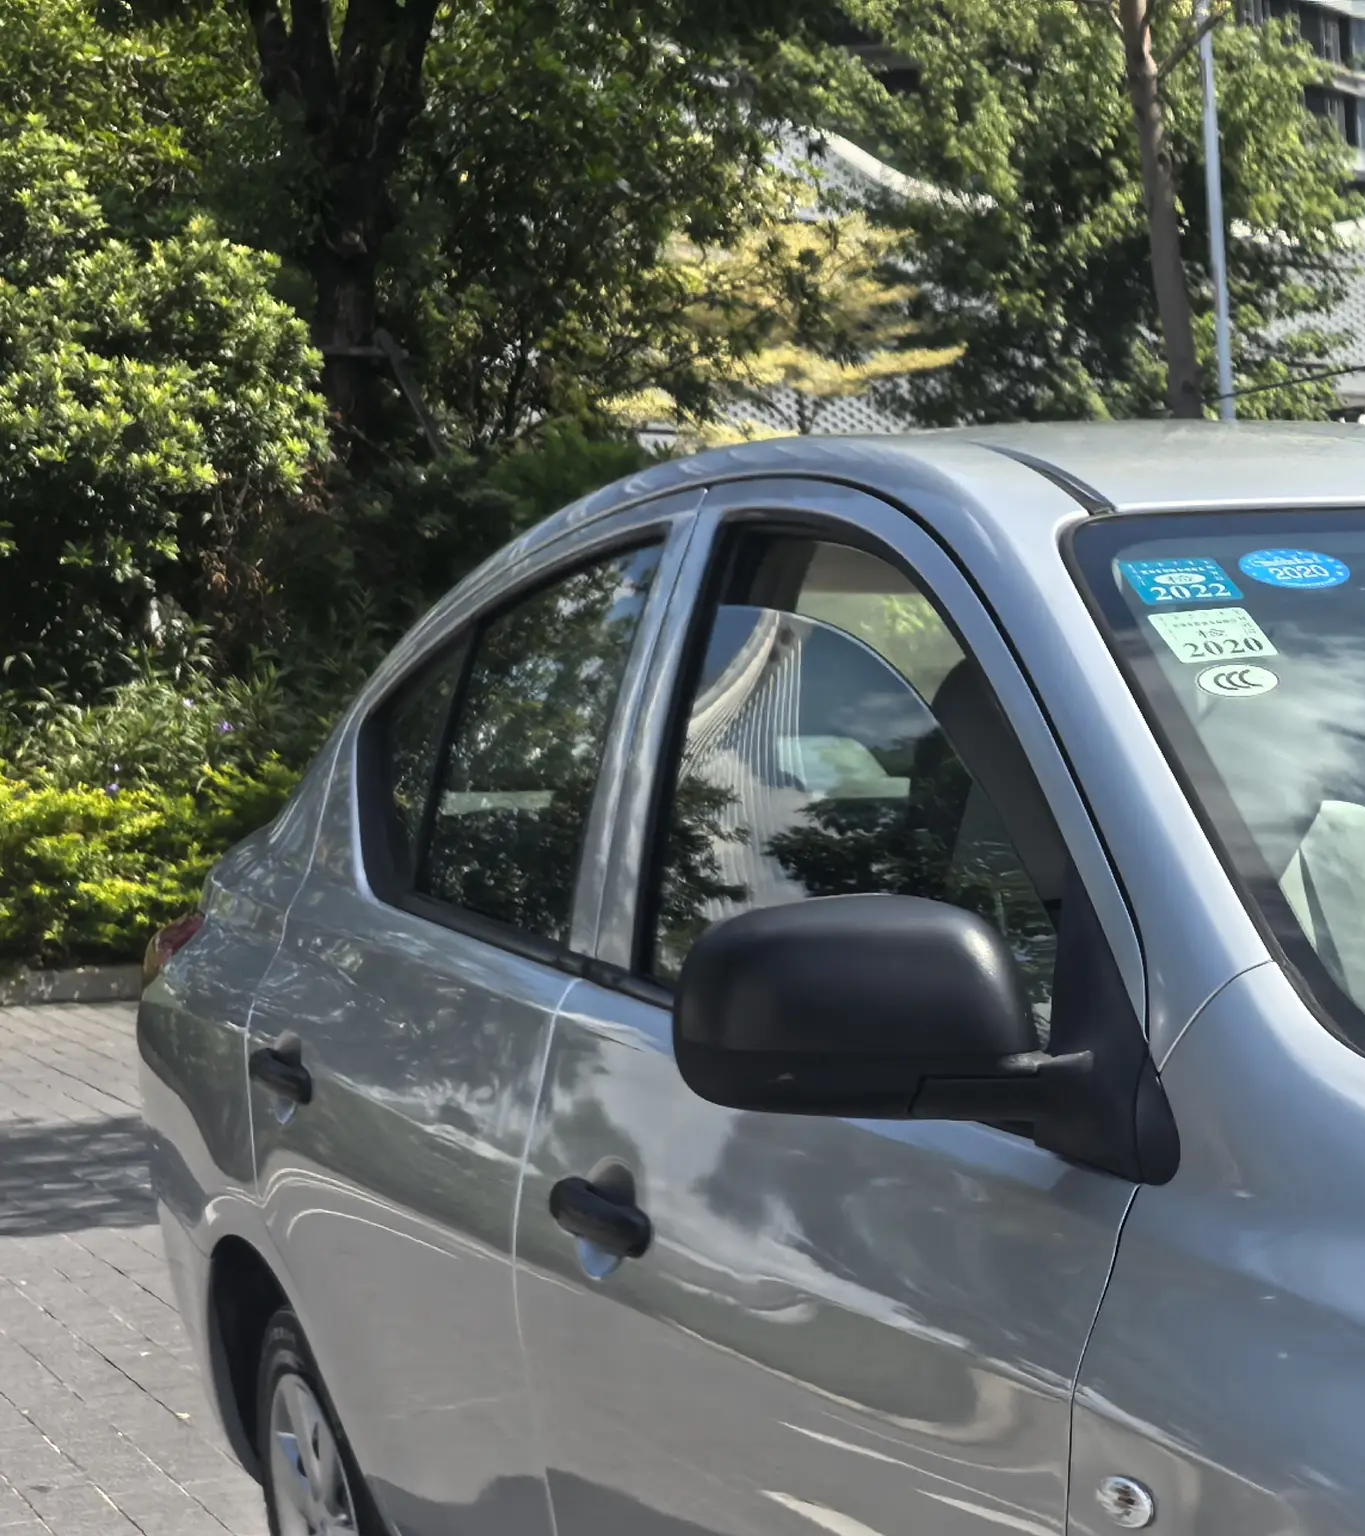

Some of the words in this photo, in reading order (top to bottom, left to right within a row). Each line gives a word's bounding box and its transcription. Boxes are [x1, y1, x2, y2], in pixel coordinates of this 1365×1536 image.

[1268, 564, 1330, 580] 2020
[1150, 583, 1231, 600] 2022
[1183, 637, 1263, 658] 2020
